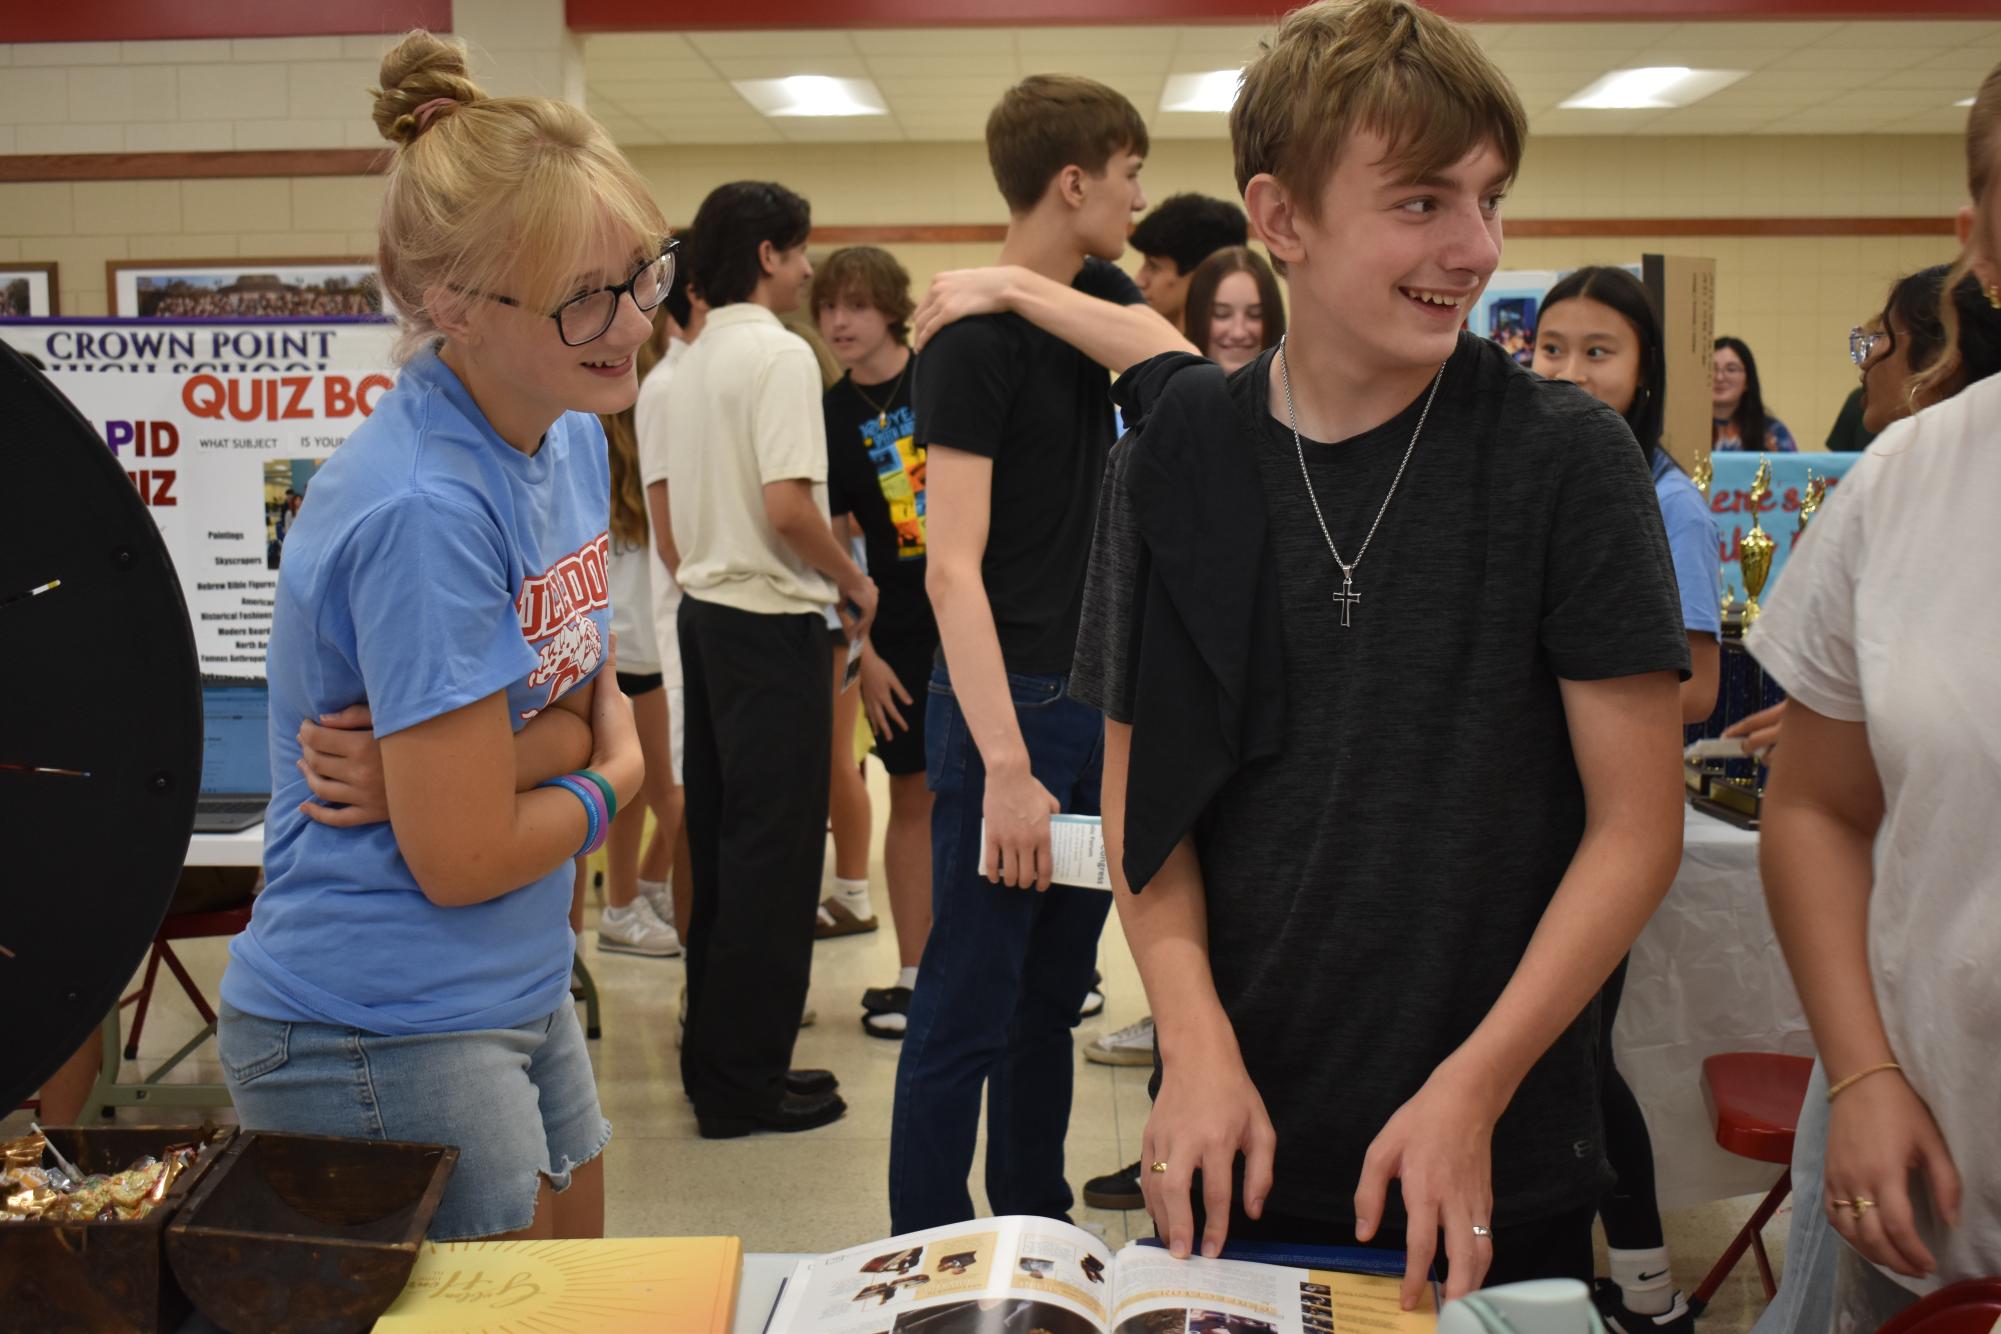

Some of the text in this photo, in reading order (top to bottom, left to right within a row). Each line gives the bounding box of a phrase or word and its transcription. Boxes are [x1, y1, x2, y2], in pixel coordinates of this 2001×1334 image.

[46, 330, 337, 360] CROWN POINT
[182, 374, 314, 422] QUIZ
[200, 438, 229, 448] WHAT
[232, 438, 278, 449] SUBJECT
[301, 436, 311, 448] IS
[127, 469, 177, 506] IZ
[208, 531, 244, 541] Paintings
[215, 557, 262, 566] Skyscrapers
[197, 581, 276, 590] Hebrew Bible Figures
[201, 612, 237, 620] Historical
[218, 627, 271, 636] Modern Board
[235, 641, 256, 649] North
[201, 654, 228, 662] Famous
